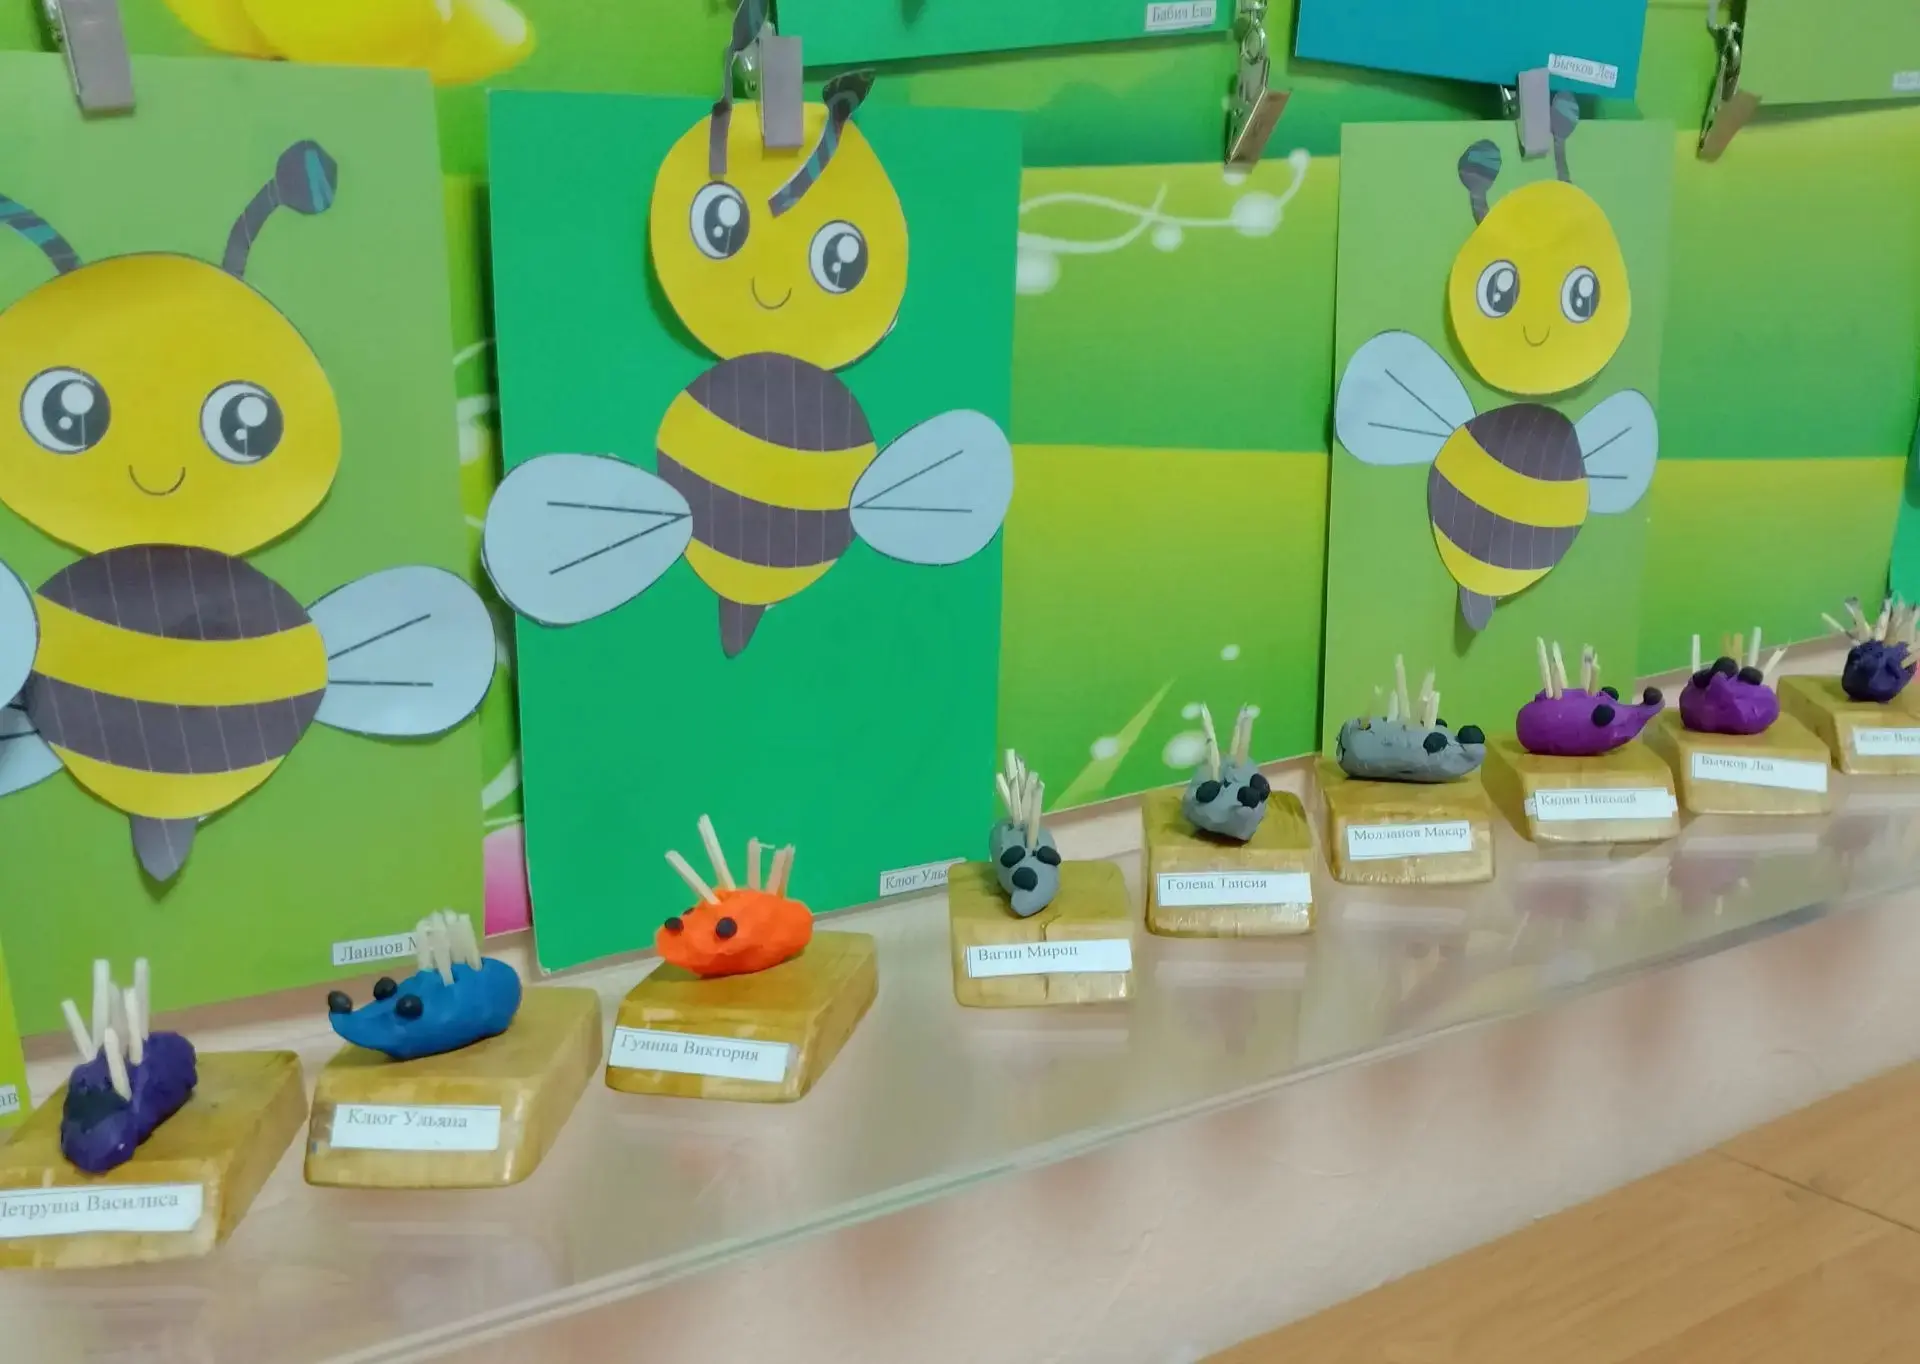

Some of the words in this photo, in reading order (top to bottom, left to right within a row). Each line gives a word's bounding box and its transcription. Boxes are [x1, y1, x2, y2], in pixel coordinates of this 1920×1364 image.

[1552, 56, 1594, 76] Бычков
[1424, 827, 1468, 839] Макар
[1167, 878, 1214, 891] Голева
[1220, 877, 1267, 890] Таисия
[340, 942, 404, 962] Ланцов
[977, 947, 1022, 962] Вагин
[620, 1033, 679, 1054] Гунина
[683, 1039, 761, 1062] Виктория
[346, 1108, 399, 1125] Клюг
[402, 1111, 468, 1128] Ульяна
[86, 1193, 179, 1212] Василиса
